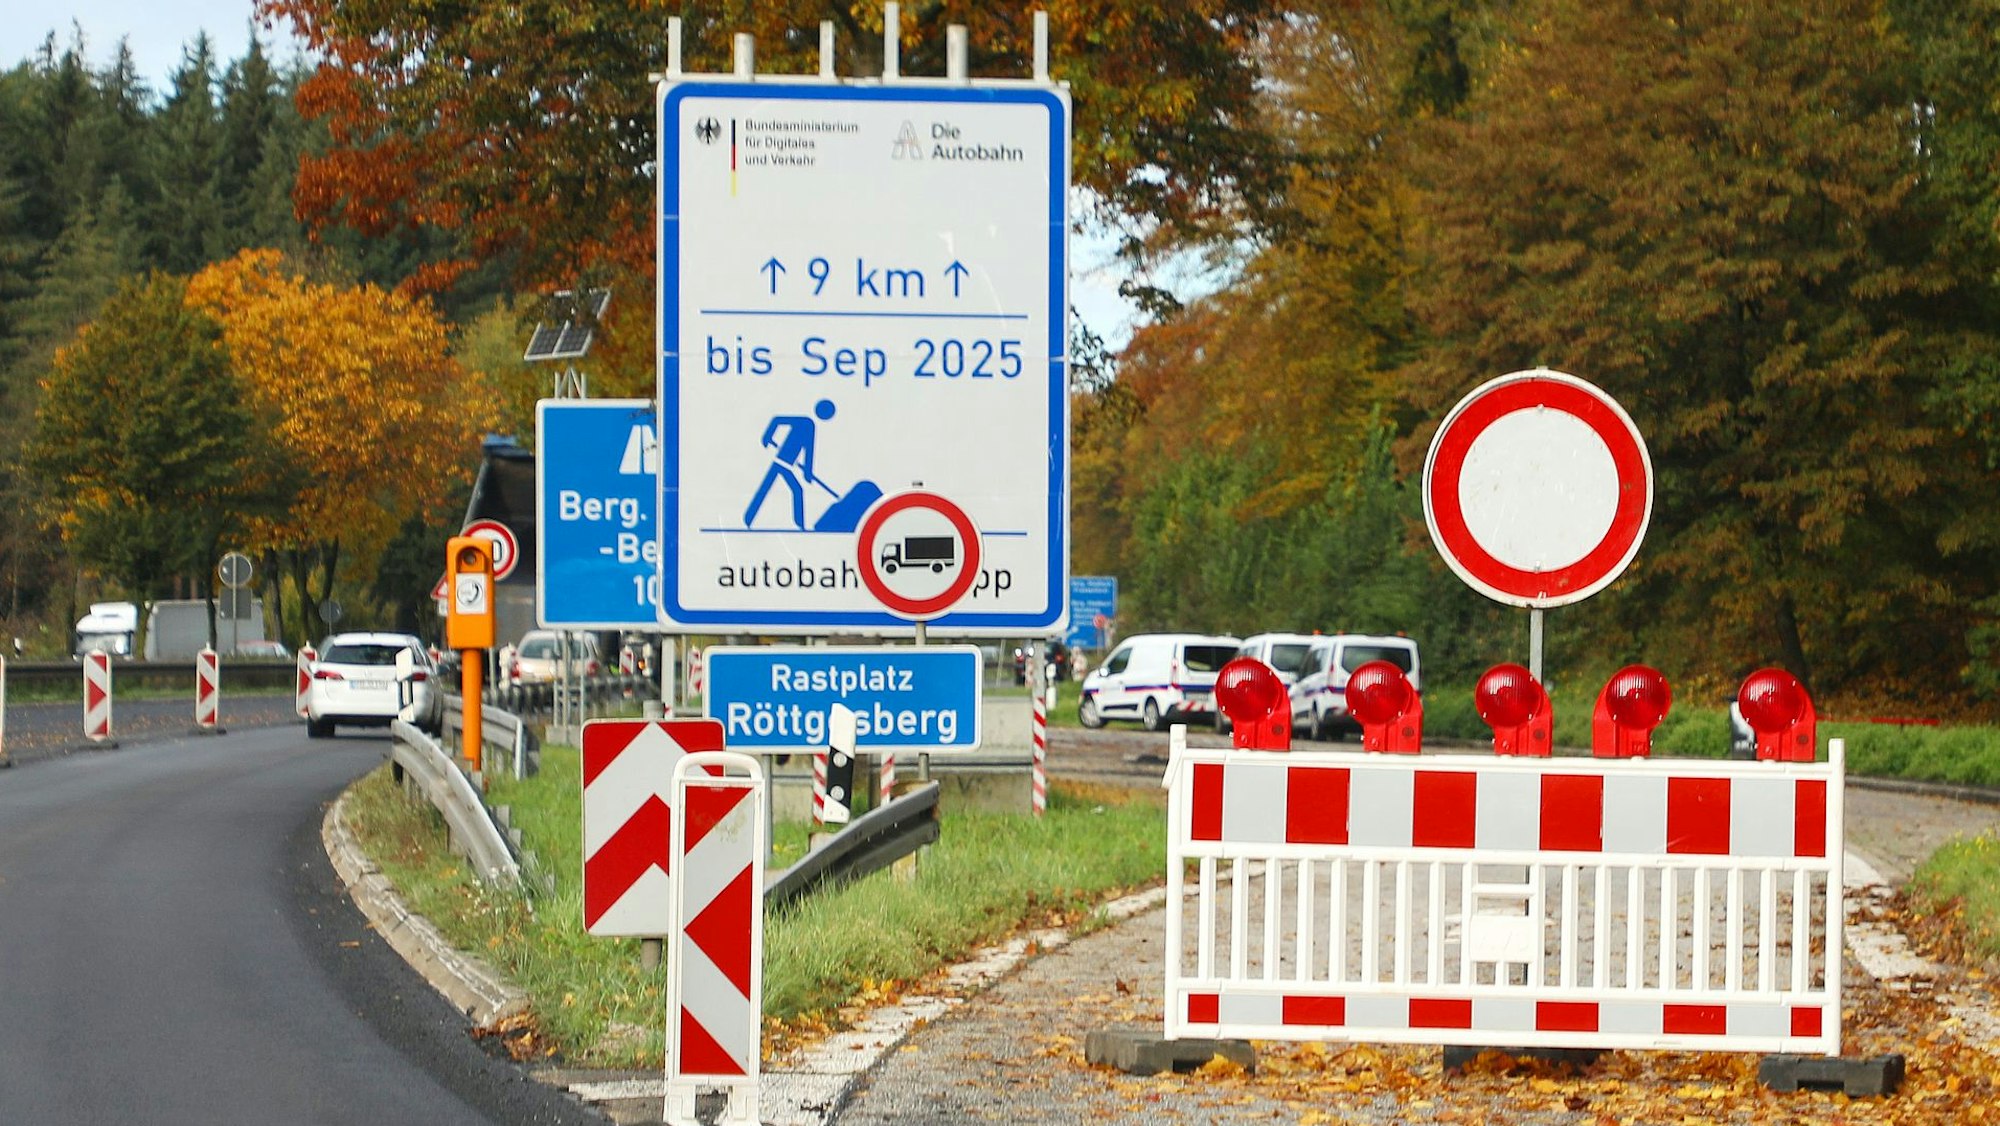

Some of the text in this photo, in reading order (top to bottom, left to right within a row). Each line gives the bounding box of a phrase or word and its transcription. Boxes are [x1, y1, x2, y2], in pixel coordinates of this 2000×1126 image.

[745, 119, 858, 133] Bundesministerium
[931, 123, 961, 140] Die
[745, 136, 815, 151] für Digitales
[932, 145, 1024, 162] Autobahn
[745, 154, 816, 167] und Verkehr
[807, 257, 925, 297] 9 km
[706, 335, 1023, 388] bis Sep 2025
[559, 489, 647, 529] Berg.
[599, 532, 657, 564] -Be
[718, 559, 1012, 598] autobahpp
[771, 663, 914, 698] Rastplatz
[727, 702, 957, 744] Röttgsberg
